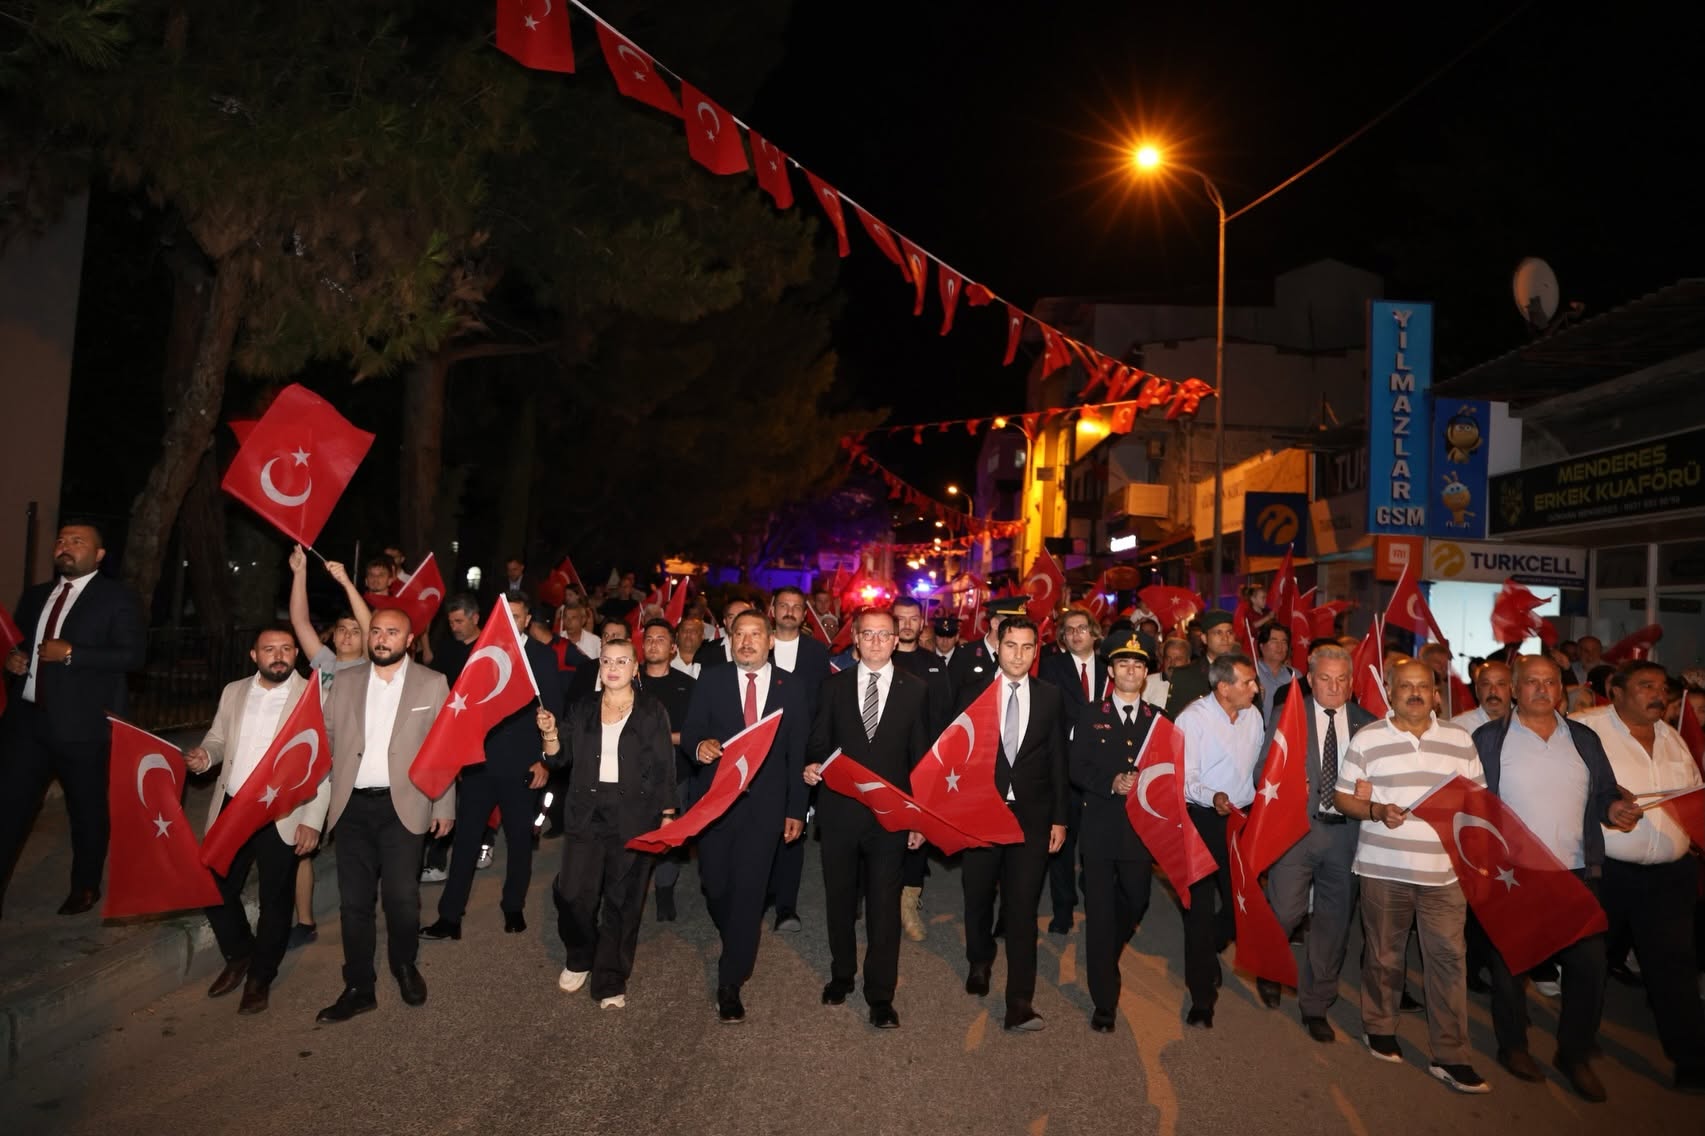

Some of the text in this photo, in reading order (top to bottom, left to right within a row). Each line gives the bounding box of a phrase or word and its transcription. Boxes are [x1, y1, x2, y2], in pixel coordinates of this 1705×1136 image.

[1391, 309, 1416, 500] YILMAZLAR
[1557, 443, 1668, 483] MENDERES
[1533, 484, 1592, 512] ERKEK
[1594, 461, 1701, 502] KUAFÖRÜ
[1376, 506, 1425, 526] GSM
[1470, 552, 1577, 575] TURKCELL
